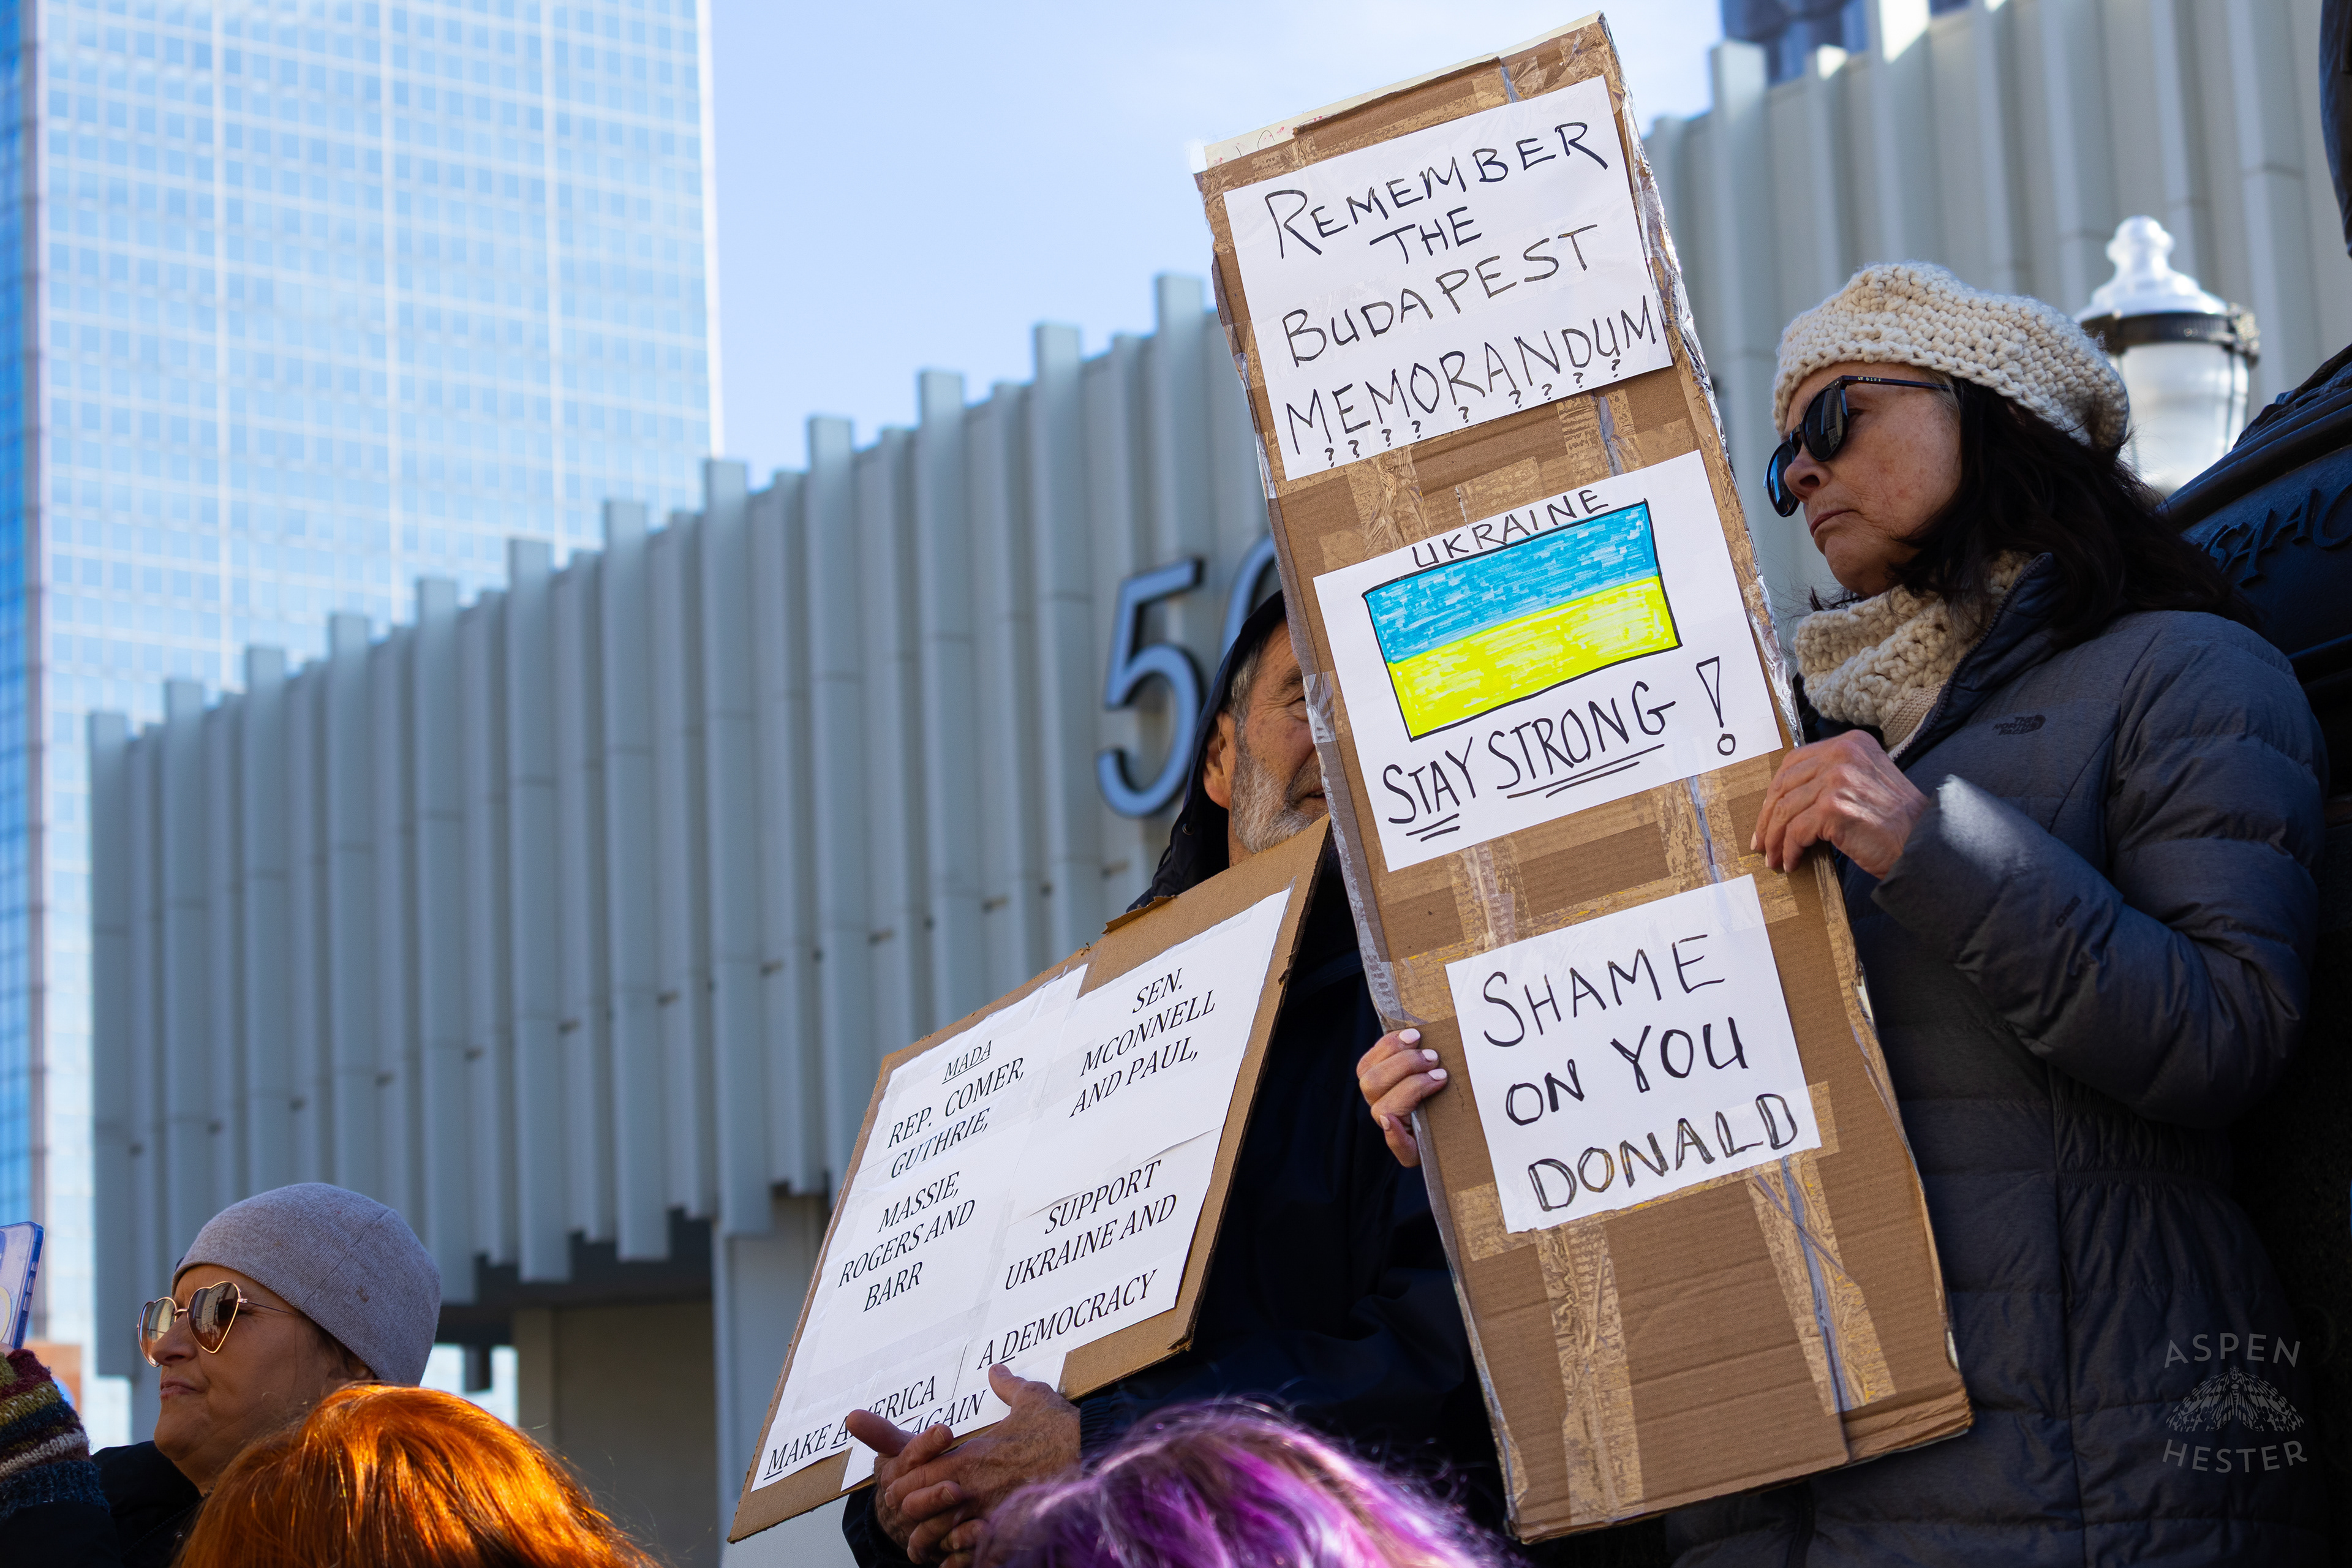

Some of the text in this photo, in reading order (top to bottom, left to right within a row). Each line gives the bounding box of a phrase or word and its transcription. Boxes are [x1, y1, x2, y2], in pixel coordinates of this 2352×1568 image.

[1265, 123, 1608, 259] REMEMBER
[1370, 206, 1482, 264] THE
[1283, 225, 1597, 368] BUDAPEST
[1286, 295, 1656, 454] MEMORANDUM
[1411, 489, 1609, 568] UKRAINE
[1383, 737, 1476, 824] STAY
[1079, 989, 1216, 1077] MCONNELL
[1133, 968, 1183, 1014] SEN.
[1483, 934, 1725, 1047] SHAME
[888, 1058, 1024, 1149] REP. COMER,
[943, 1041, 991, 1081] MADA
[1069, 1036, 1199, 1117] AND PAUL,
[1506, 1017, 1749, 1126] ON YOU
[891, 1107, 990, 1178] GUTHRIE,
[1528, 1093, 1798, 1212] DONALD
[878, 1170, 960, 1233] MASSIE,
[1045, 1159, 1162, 1235] SUPPORT
[839, 1199, 975, 1288] ROGERS AND
[1006, 1194, 1177, 1291] UKRAINE AND
[863, 1261, 923, 1313] BARR
[766, 1423, 832, 1476] MAKE
[977, 1340, 993, 1370] A
[999, 1268, 1157, 1361] DEMOCRACY
